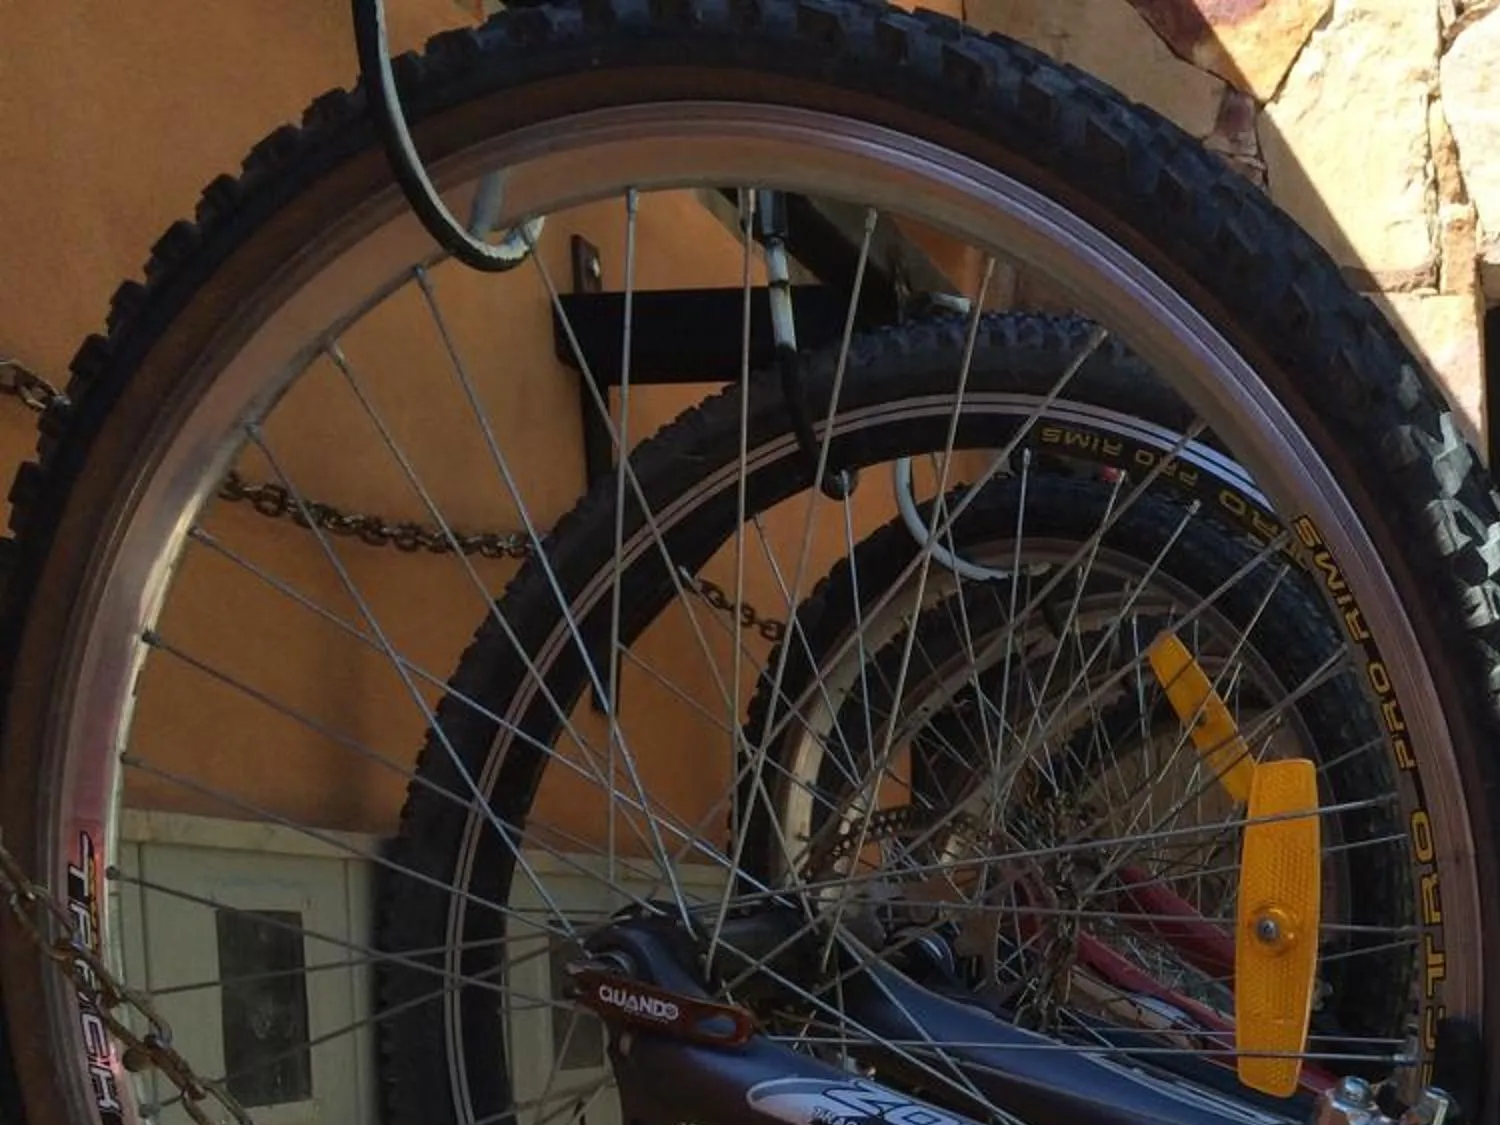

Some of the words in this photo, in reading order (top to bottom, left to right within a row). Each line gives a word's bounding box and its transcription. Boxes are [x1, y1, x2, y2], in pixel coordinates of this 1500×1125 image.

[1040, 425, 1122, 459] RIMS
[1296, 515, 1370, 646] RIMS
[1368, 662, 1417, 770] PRO
[599, 986, 679, 1022] QUANDO
